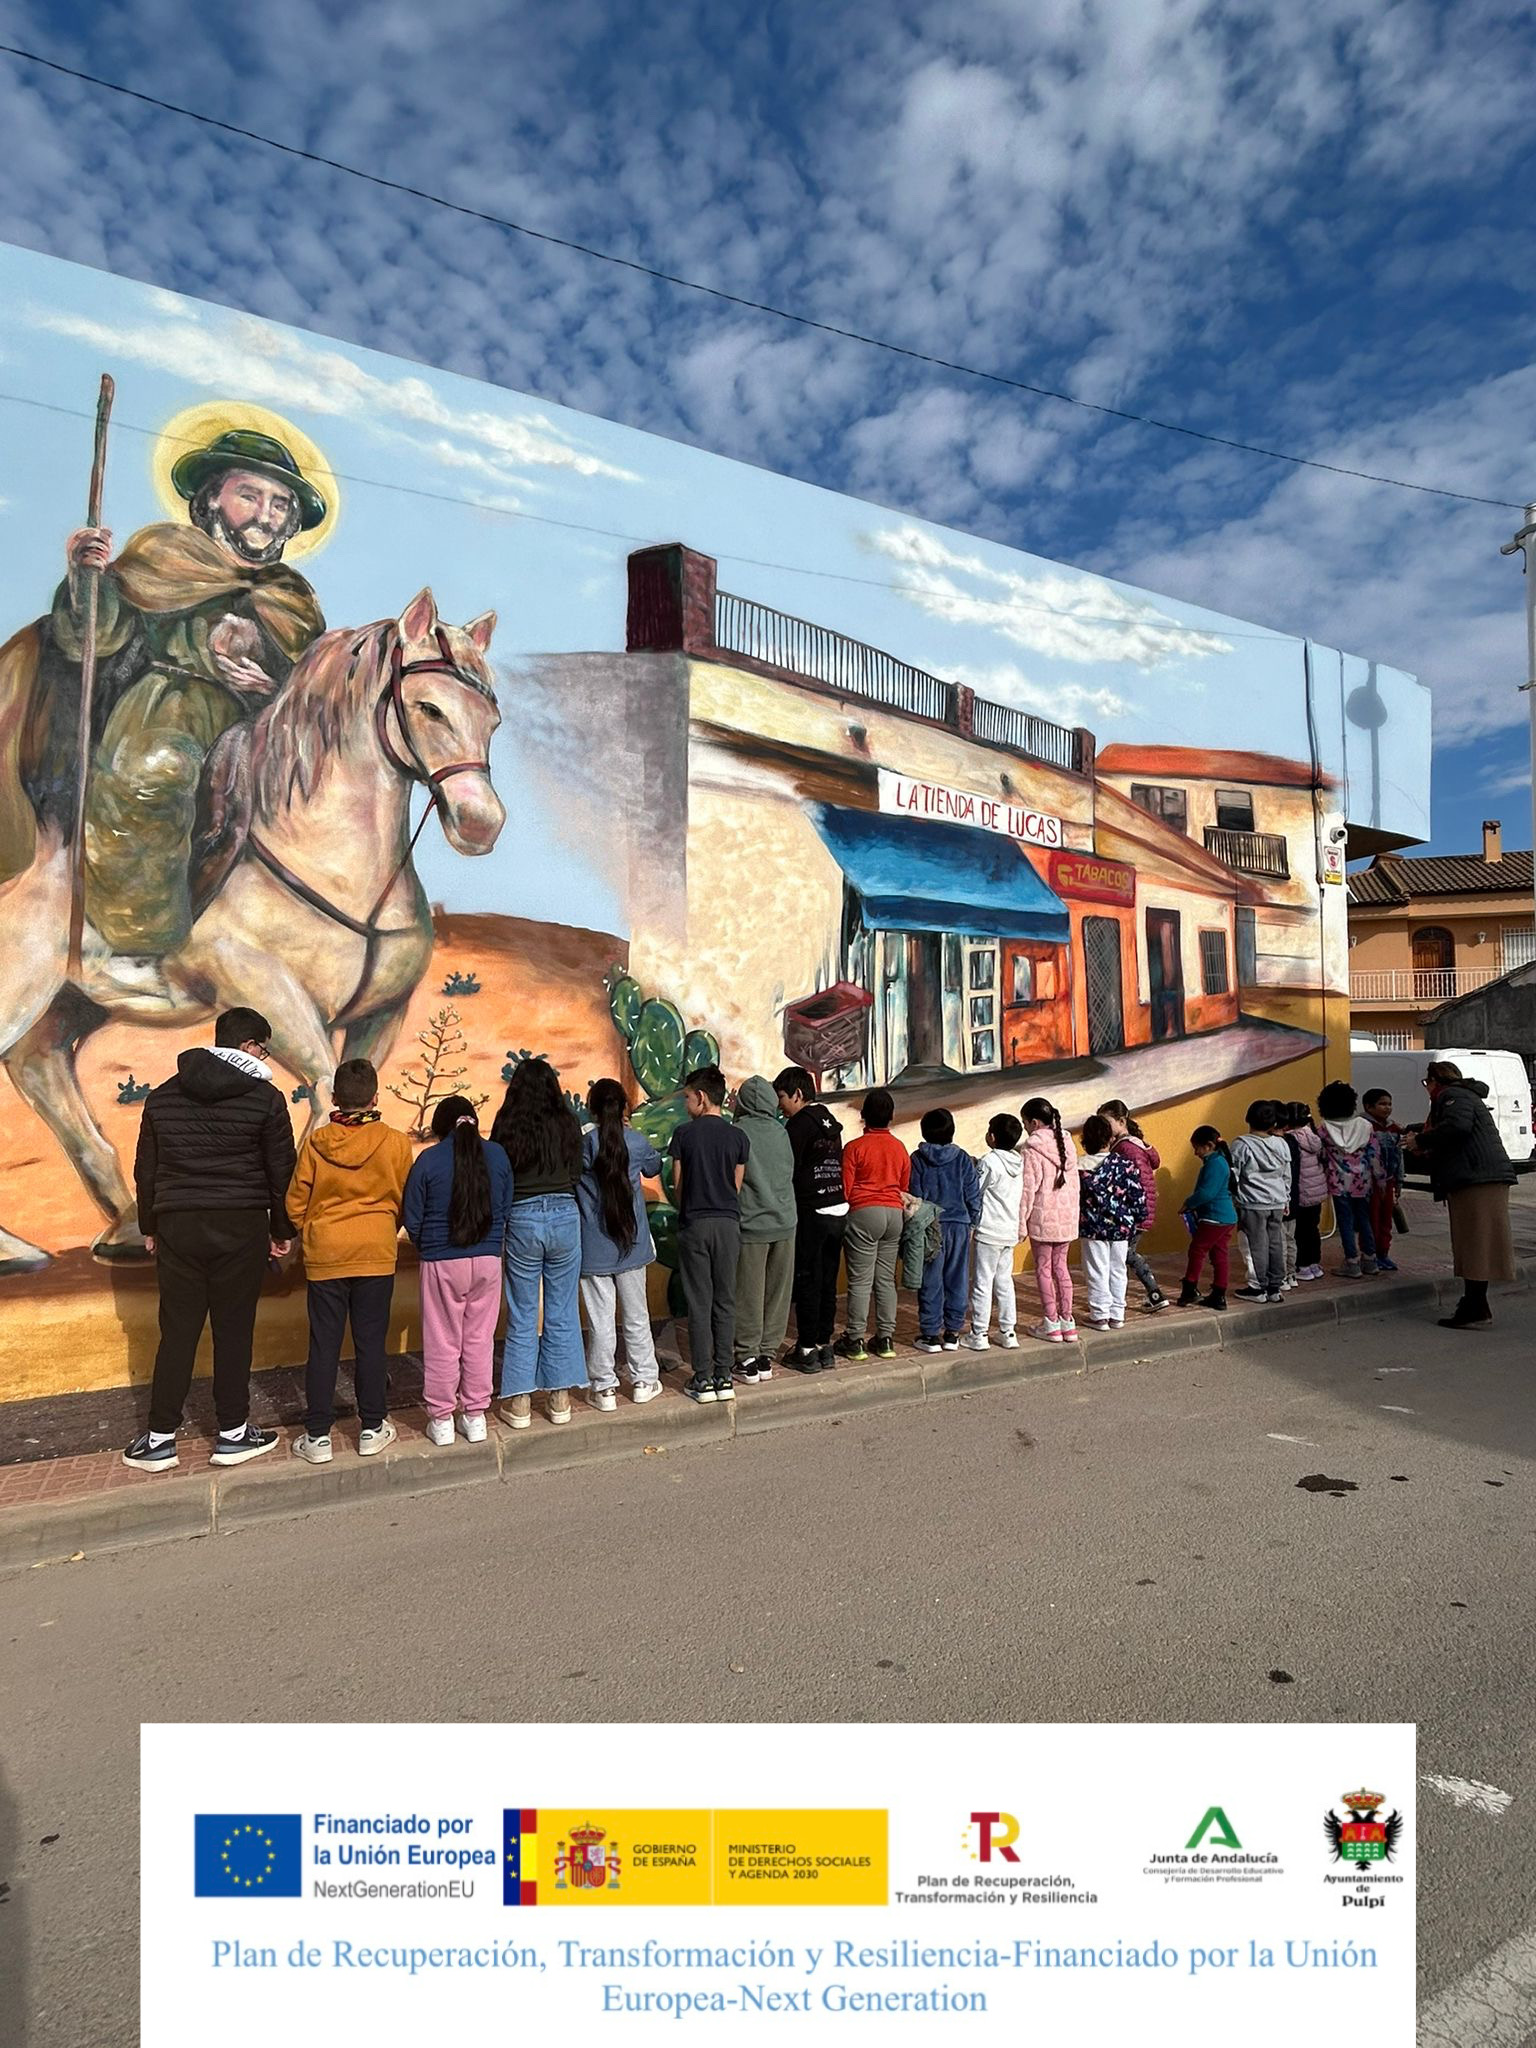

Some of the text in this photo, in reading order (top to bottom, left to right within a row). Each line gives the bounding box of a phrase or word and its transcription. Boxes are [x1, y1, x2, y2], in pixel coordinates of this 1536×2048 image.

[981, 799, 999, 830] DE
[1008, 807, 1059, 844] LUCAS
[1075, 863, 1130, 889] TABACOS
